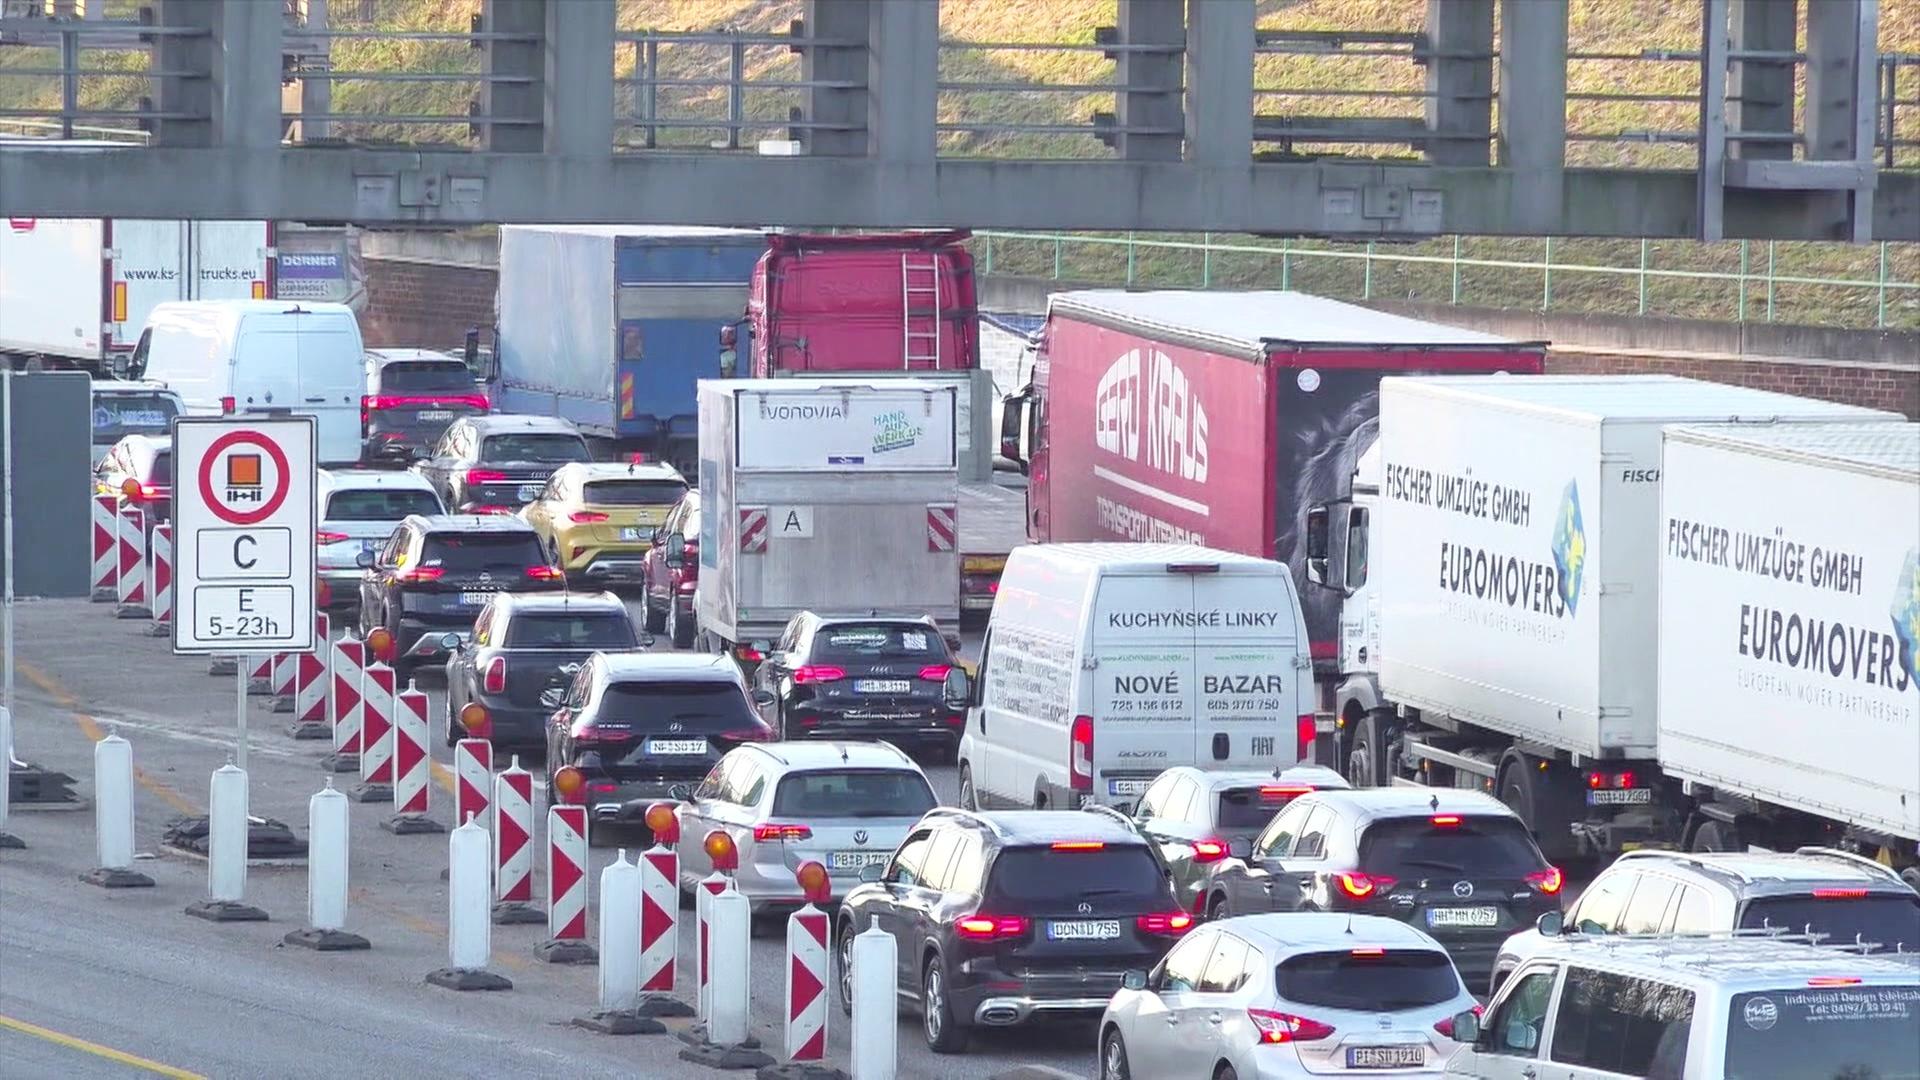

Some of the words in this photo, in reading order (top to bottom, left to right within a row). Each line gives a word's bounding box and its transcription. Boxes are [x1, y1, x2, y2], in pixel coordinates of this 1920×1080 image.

[123, 267, 180, 280] www.ks-
[201, 267, 256, 280] trucks.eu
[873, 410, 905, 426] HAND
[1147, 347, 1209, 484] KRAUS
[1386, 463, 1431, 505] FISCHER
[1436, 467, 1488, 518] UMZÜGE
[1492, 484, 1531, 527] GMBH
[784, 510, 801, 532] A
[234, 535, 257, 569] C
[1668, 518, 1729, 568] FISCHER
[1735, 526, 1805, 583] UMZÜGE
[1811, 547, 1863, 595] GMBH
[1440, 542, 1565, 619] EUROMOVERS
[239, 589, 254, 612] E
[209, 616, 278, 636] 5-23h
[1109, 608, 1220, 628] KUCHYŇSKÉ
[1226, 612, 1278, 627] LINKY
[1738, 604, 1910, 692] EUROMOVERS
[1115, 671, 1179, 694] NOVÉ
[1204, 675, 1282, 694] BAZAR
[1111, 700, 1133, 711] 725
[1161, 700, 1183, 711] 612
[1207, 700, 1229, 711] 605
[1258, 700, 1279, 711] 750
[1737, 669, 1791, 697] EUROPEAN
[1797, 684, 1832, 708] MOVER
[1838, 691, 1910, 725] PARTNERSHIP
[1252, 737, 1274, 756] FIAT
[835, 854, 848, 866] PB
[1056, 923, 1079, 936] DON
[1097, 922, 1118, 935] 755
[1785, 993, 1838, 1006] Individual
[1808, 1004, 1828, 1014] Tel:
[1356, 1050, 1368, 1063] PI
[1395, 1049, 1421, 1061] 1910
